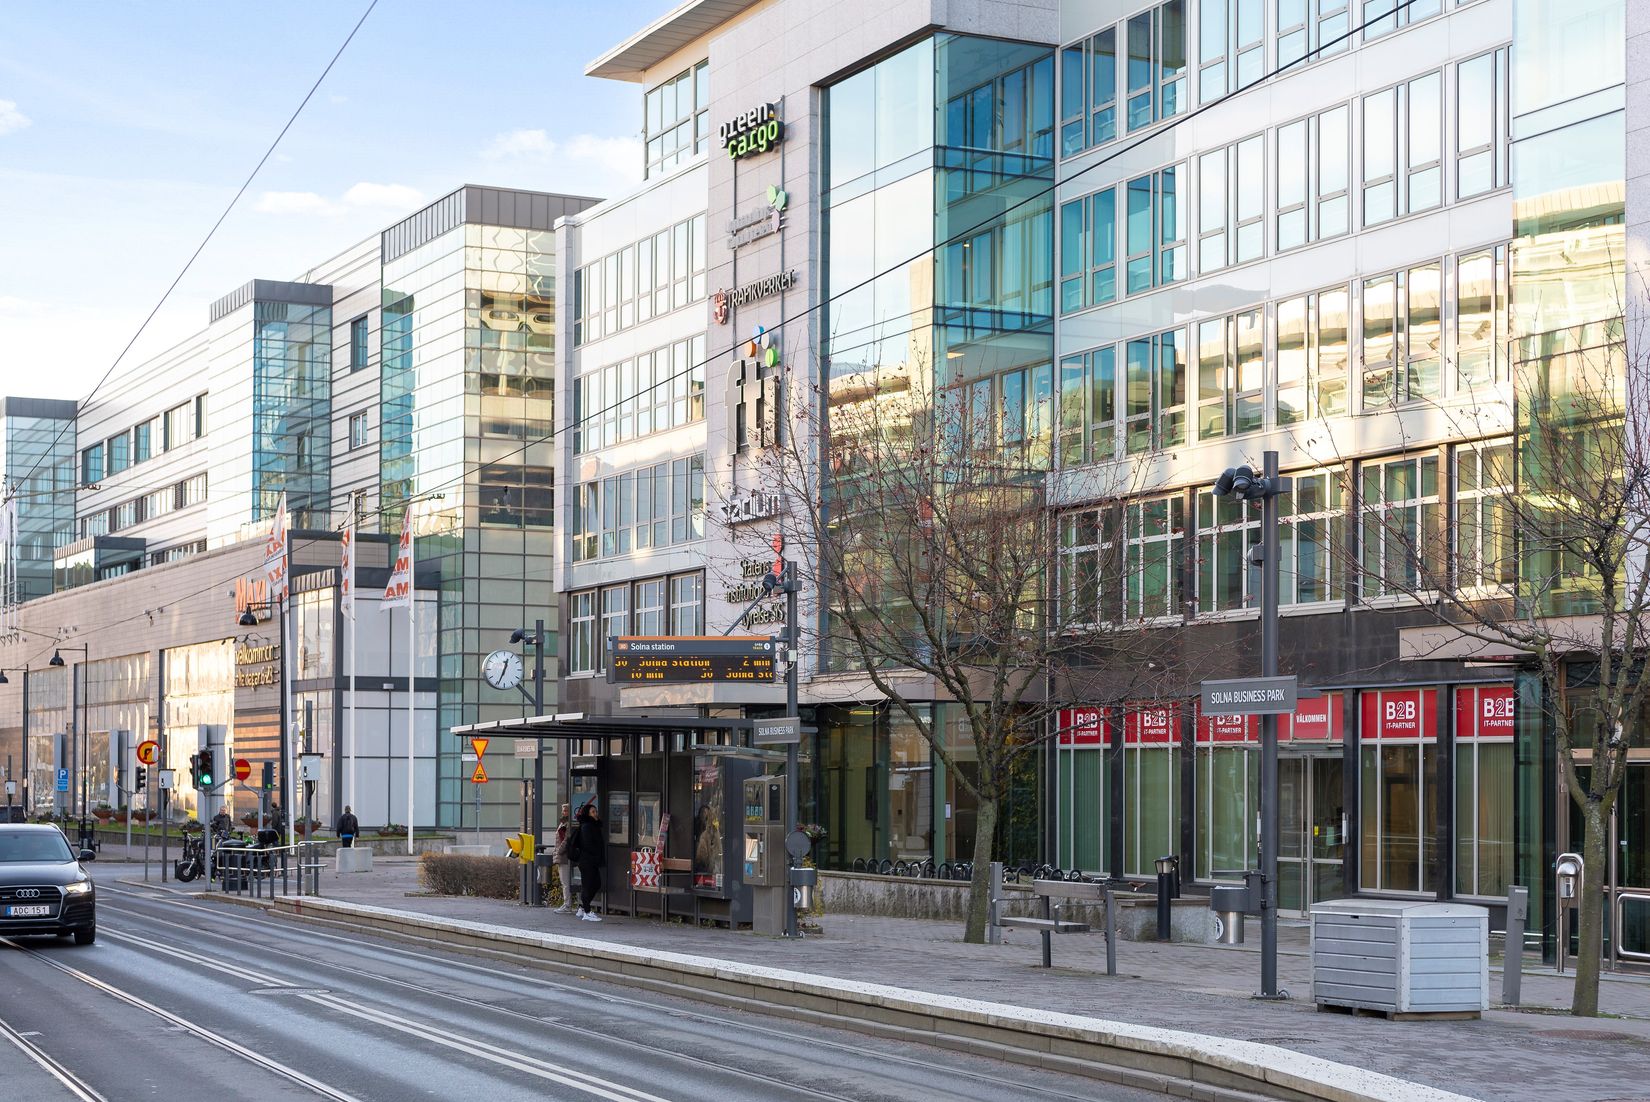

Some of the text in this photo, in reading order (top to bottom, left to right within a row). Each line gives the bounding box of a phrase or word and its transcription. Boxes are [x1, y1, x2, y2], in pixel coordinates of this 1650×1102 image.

[718, 102, 770, 149] green
[727, 119, 780, 161] cargo
[727, 270, 794, 308] TRAFIKVERKET
[739, 560, 771, 578] Statens
[630, 643, 650, 651] Solna
[651, 643, 675, 651] station
[753, 656, 771, 667] min
[646, 668, 664, 679] min
[1210, 688, 1285, 704] SOLNA BUSINESS PARK
[1385, 700, 1416, 720] B2B
[1483, 697, 1515, 718] B2B
[1076, 712, 1098, 729] B2B
[1143, 709, 1167, 727] B2B
[1296, 713, 1327, 724] VÄLKOMMEN
[1385, 721, 1416, 730] IT-PARTNER
[13, 906, 46, 915] ADC 151
